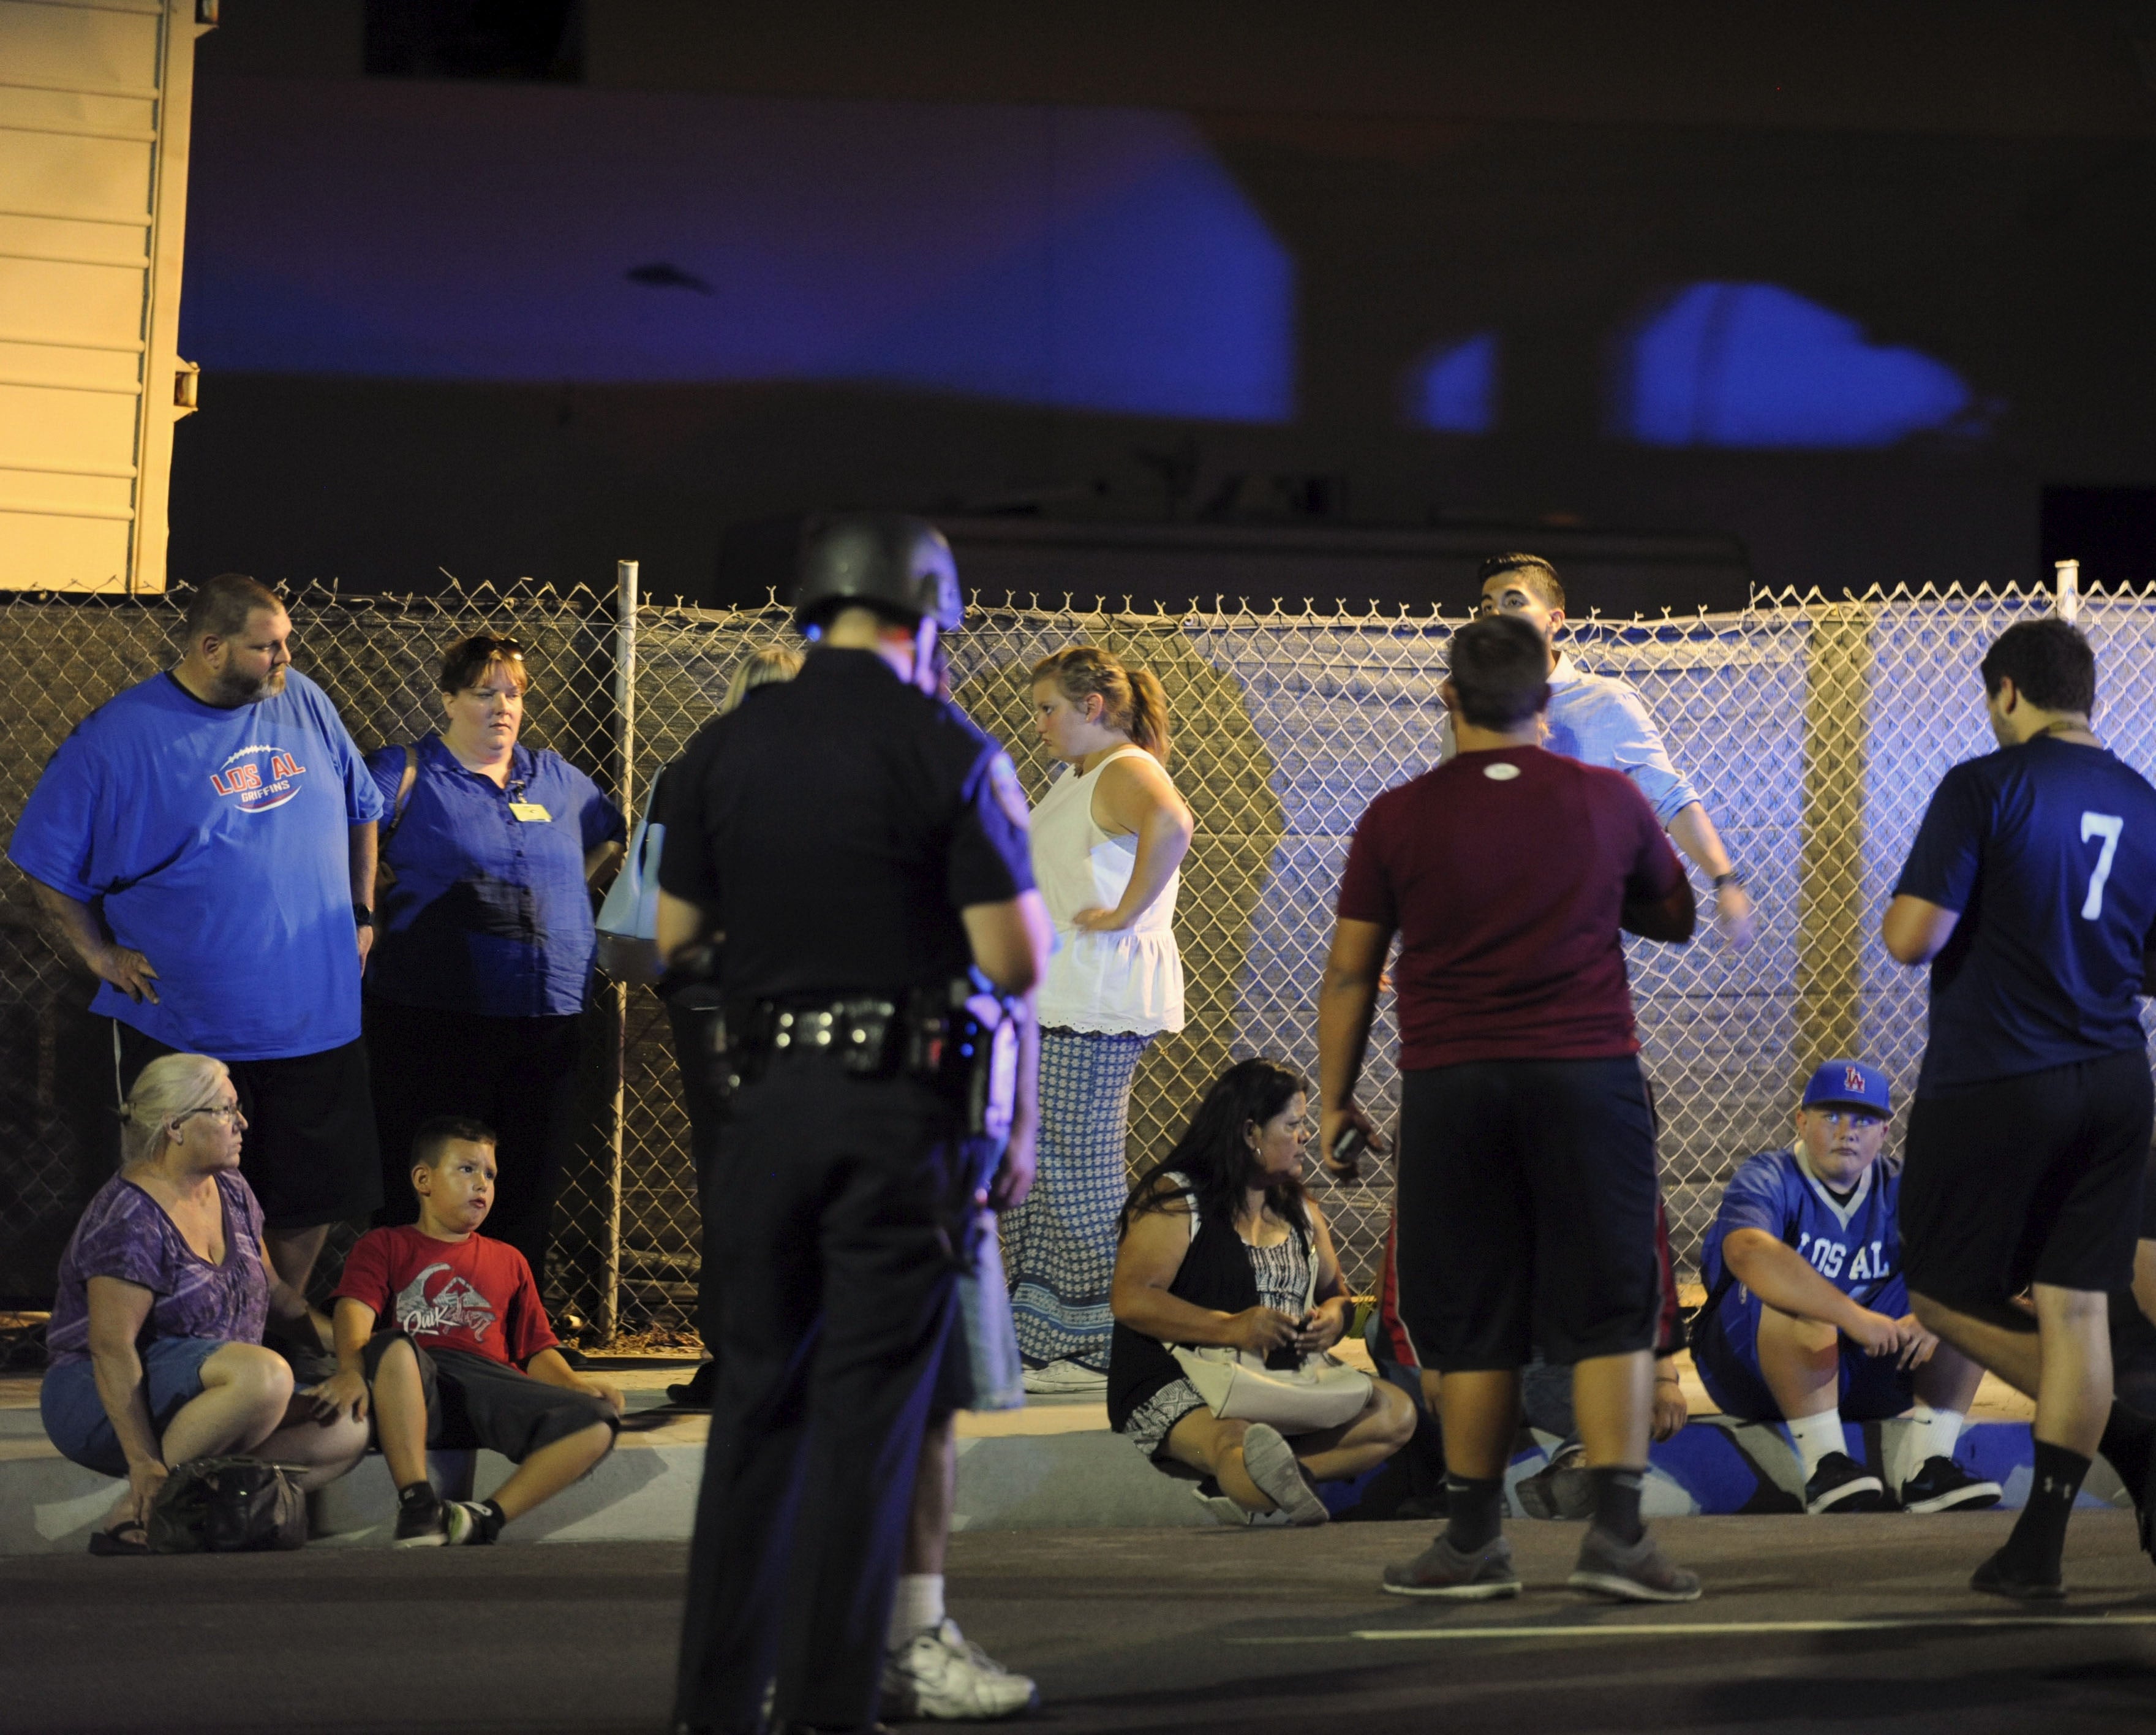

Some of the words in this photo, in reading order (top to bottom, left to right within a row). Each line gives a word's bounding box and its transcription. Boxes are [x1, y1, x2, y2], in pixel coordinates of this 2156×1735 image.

[209, 763, 262, 796] LOS
[271, 752, 306, 781] AL
[241, 780, 290, 803] GRIFFINS
[2081, 811, 2124, 921] 7
[1844, 1066, 1865, 1094] LA
[1849, 1240, 1890, 1280] AL
